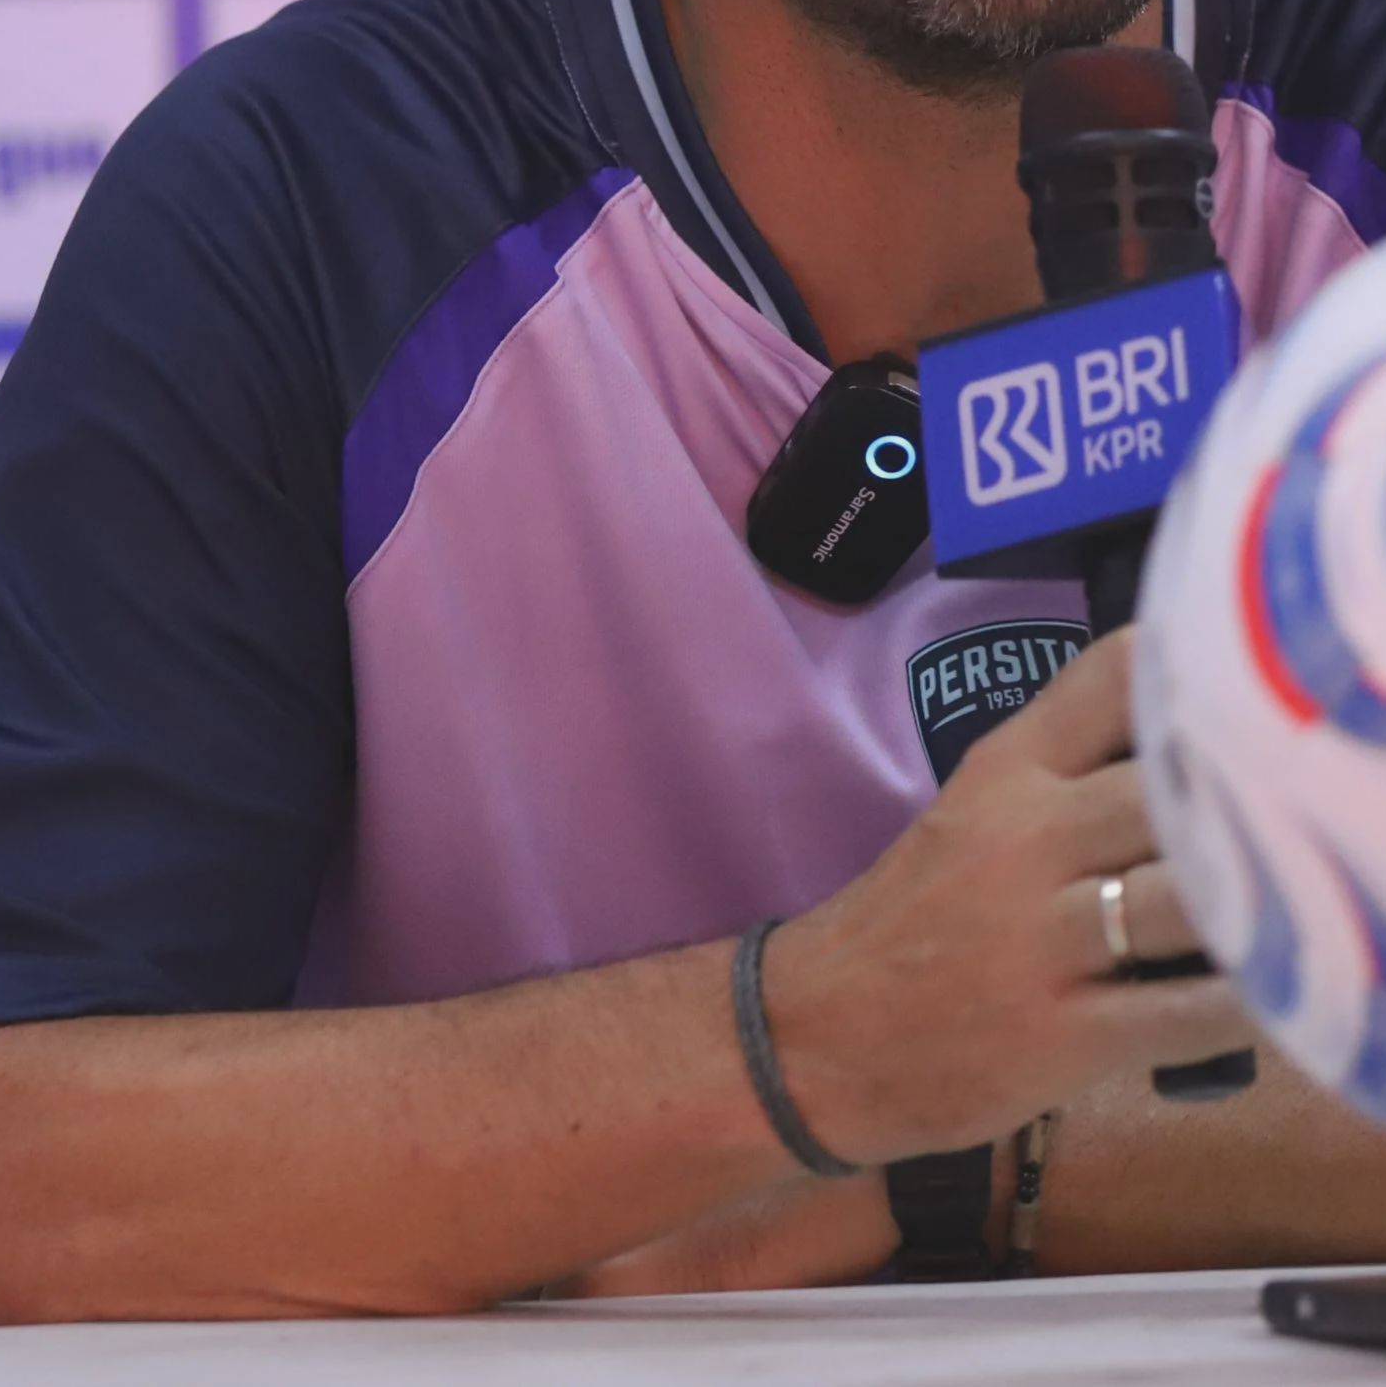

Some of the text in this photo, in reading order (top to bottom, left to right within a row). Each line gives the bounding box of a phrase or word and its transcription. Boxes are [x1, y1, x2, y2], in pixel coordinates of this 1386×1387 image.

[1074, 325, 1191, 428] BRI
[1082, 418, 1165, 477] KPR
[812, 486, 876, 563] Saramonic
[985, 686, 1025, 710] 1953
